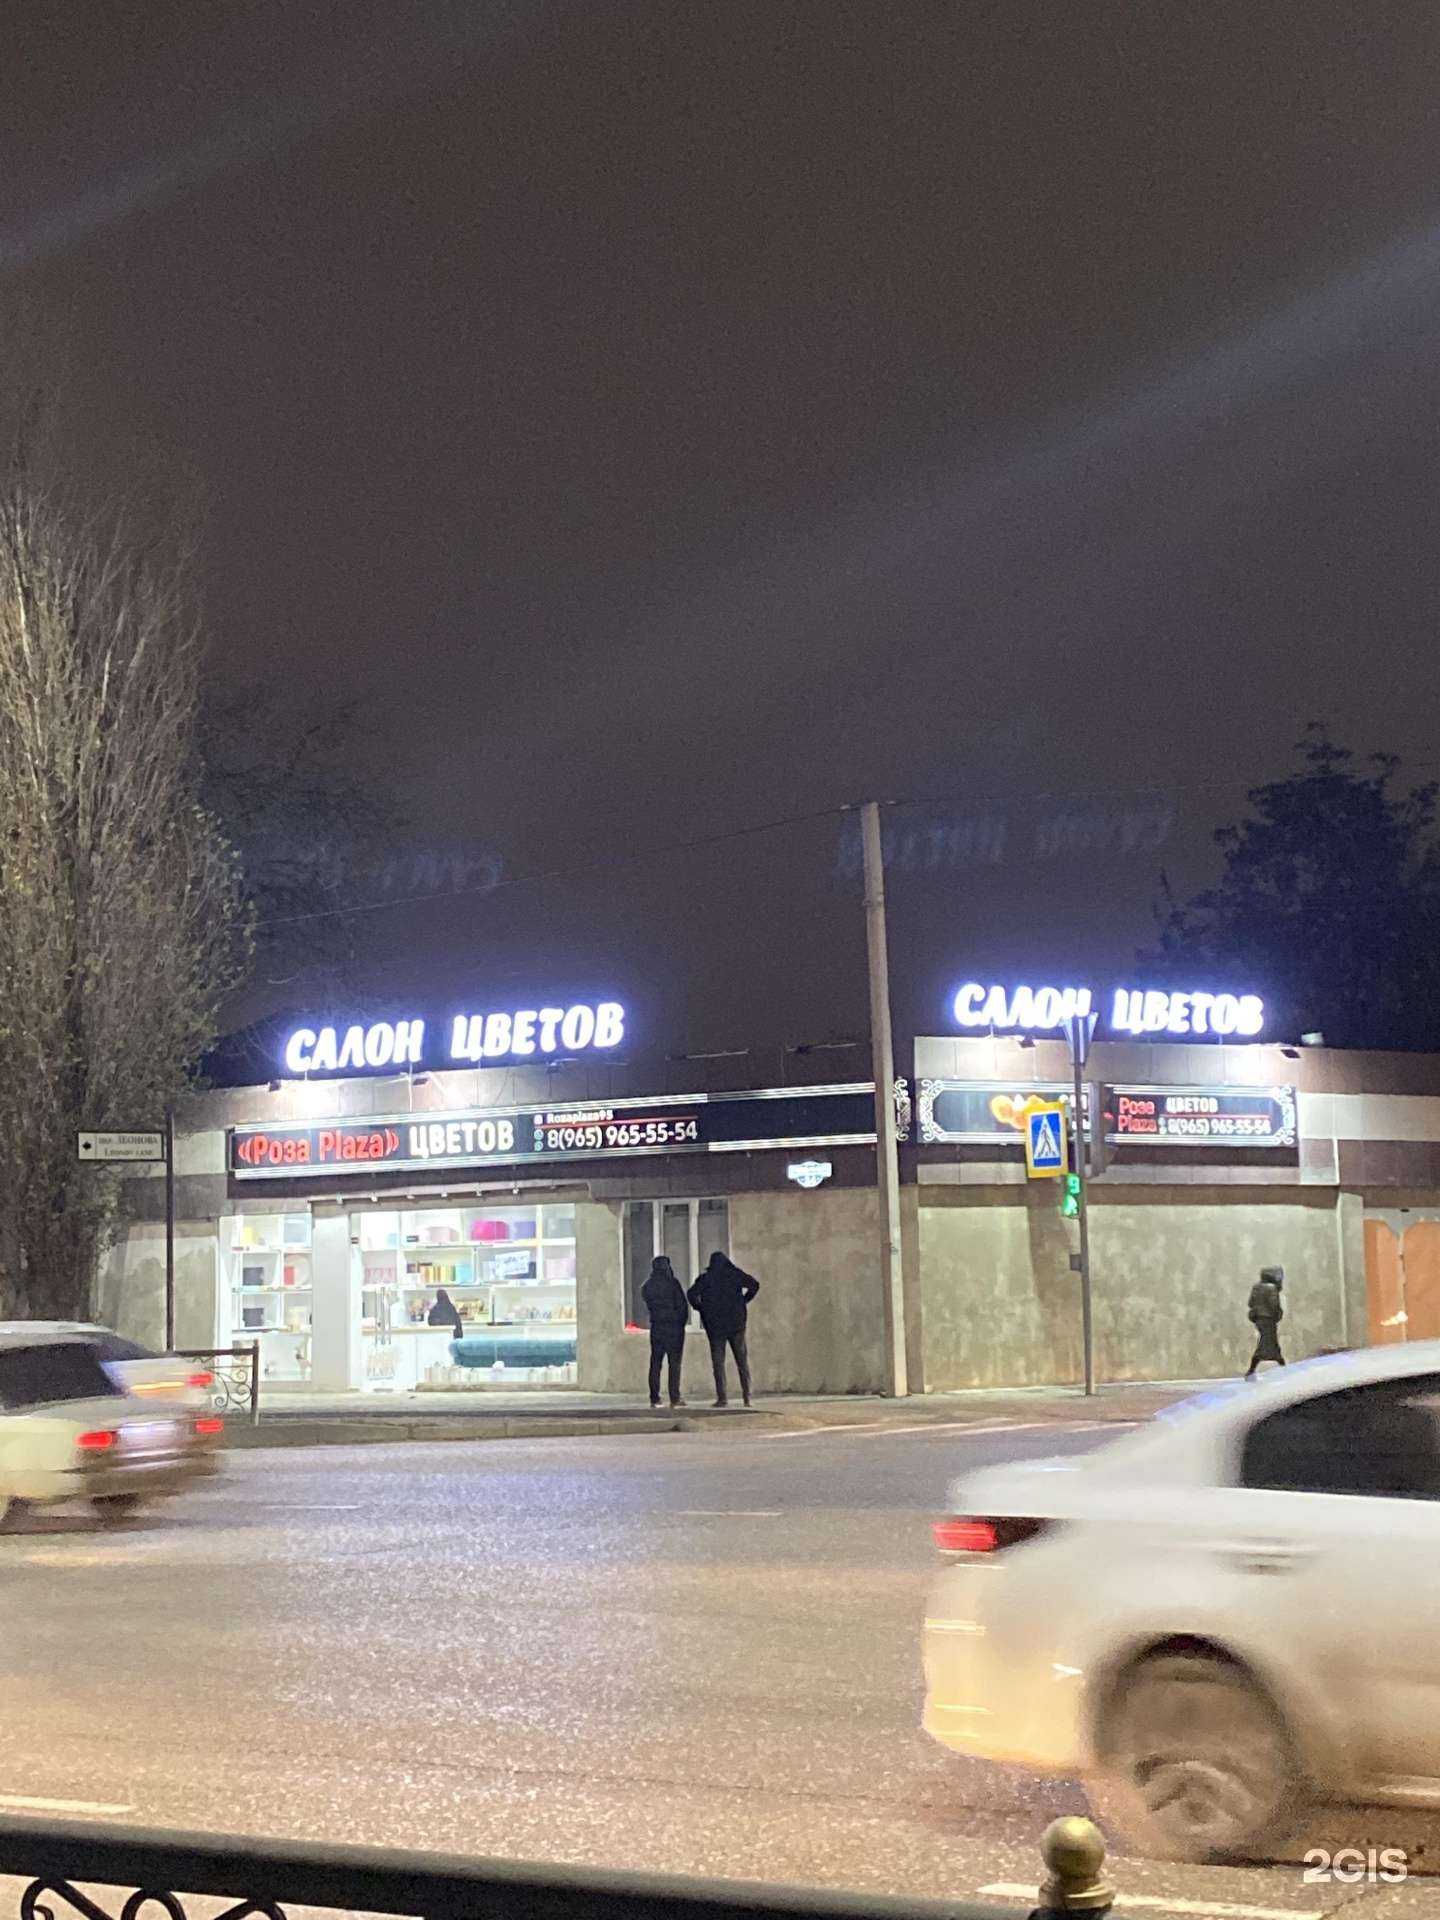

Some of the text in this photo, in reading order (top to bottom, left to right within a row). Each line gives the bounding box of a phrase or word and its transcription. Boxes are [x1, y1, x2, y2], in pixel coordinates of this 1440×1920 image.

[954, 983, 1265, 1035] САЛОН ЦВЕТОВ
[285, 1001, 626, 1072] САЛОН ЦВЕТОВ
[1165, 1096, 1219, 1114] ЦВЕТОВ
[409, 1120, 514, 1159] ЦВЕТОВ
[547, 1120, 698, 1150] 8(965) 965-55-54
